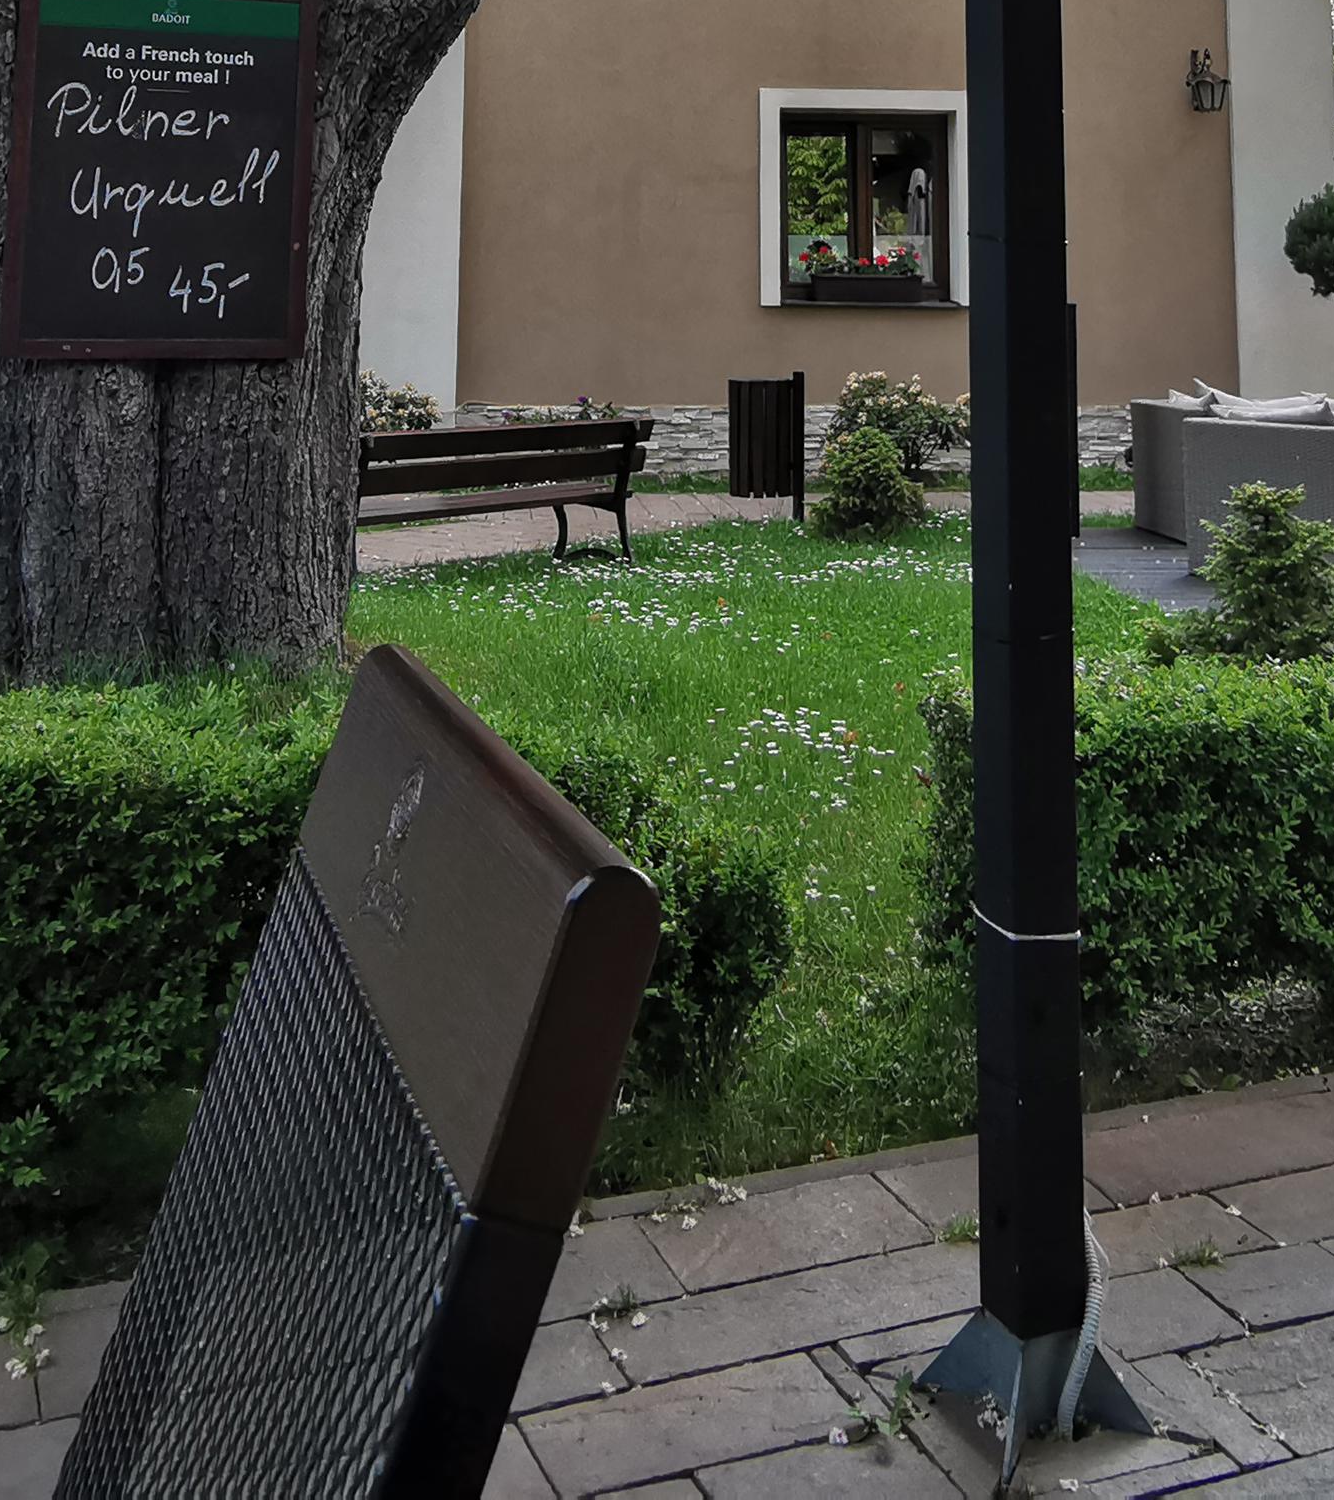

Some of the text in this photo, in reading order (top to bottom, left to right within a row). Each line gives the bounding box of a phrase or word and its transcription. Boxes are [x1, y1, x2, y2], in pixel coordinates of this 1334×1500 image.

[151, 12, 191, 25] BADOIT
[82, 41, 255, 66] Add a French touch
[106, 65, 124, 80] to
[129, 68, 170, 84] your
[175, 69, 218, 84] meal
[46, 82, 230, 141] Pilner
[70, 147, 280, 238] Urquell
